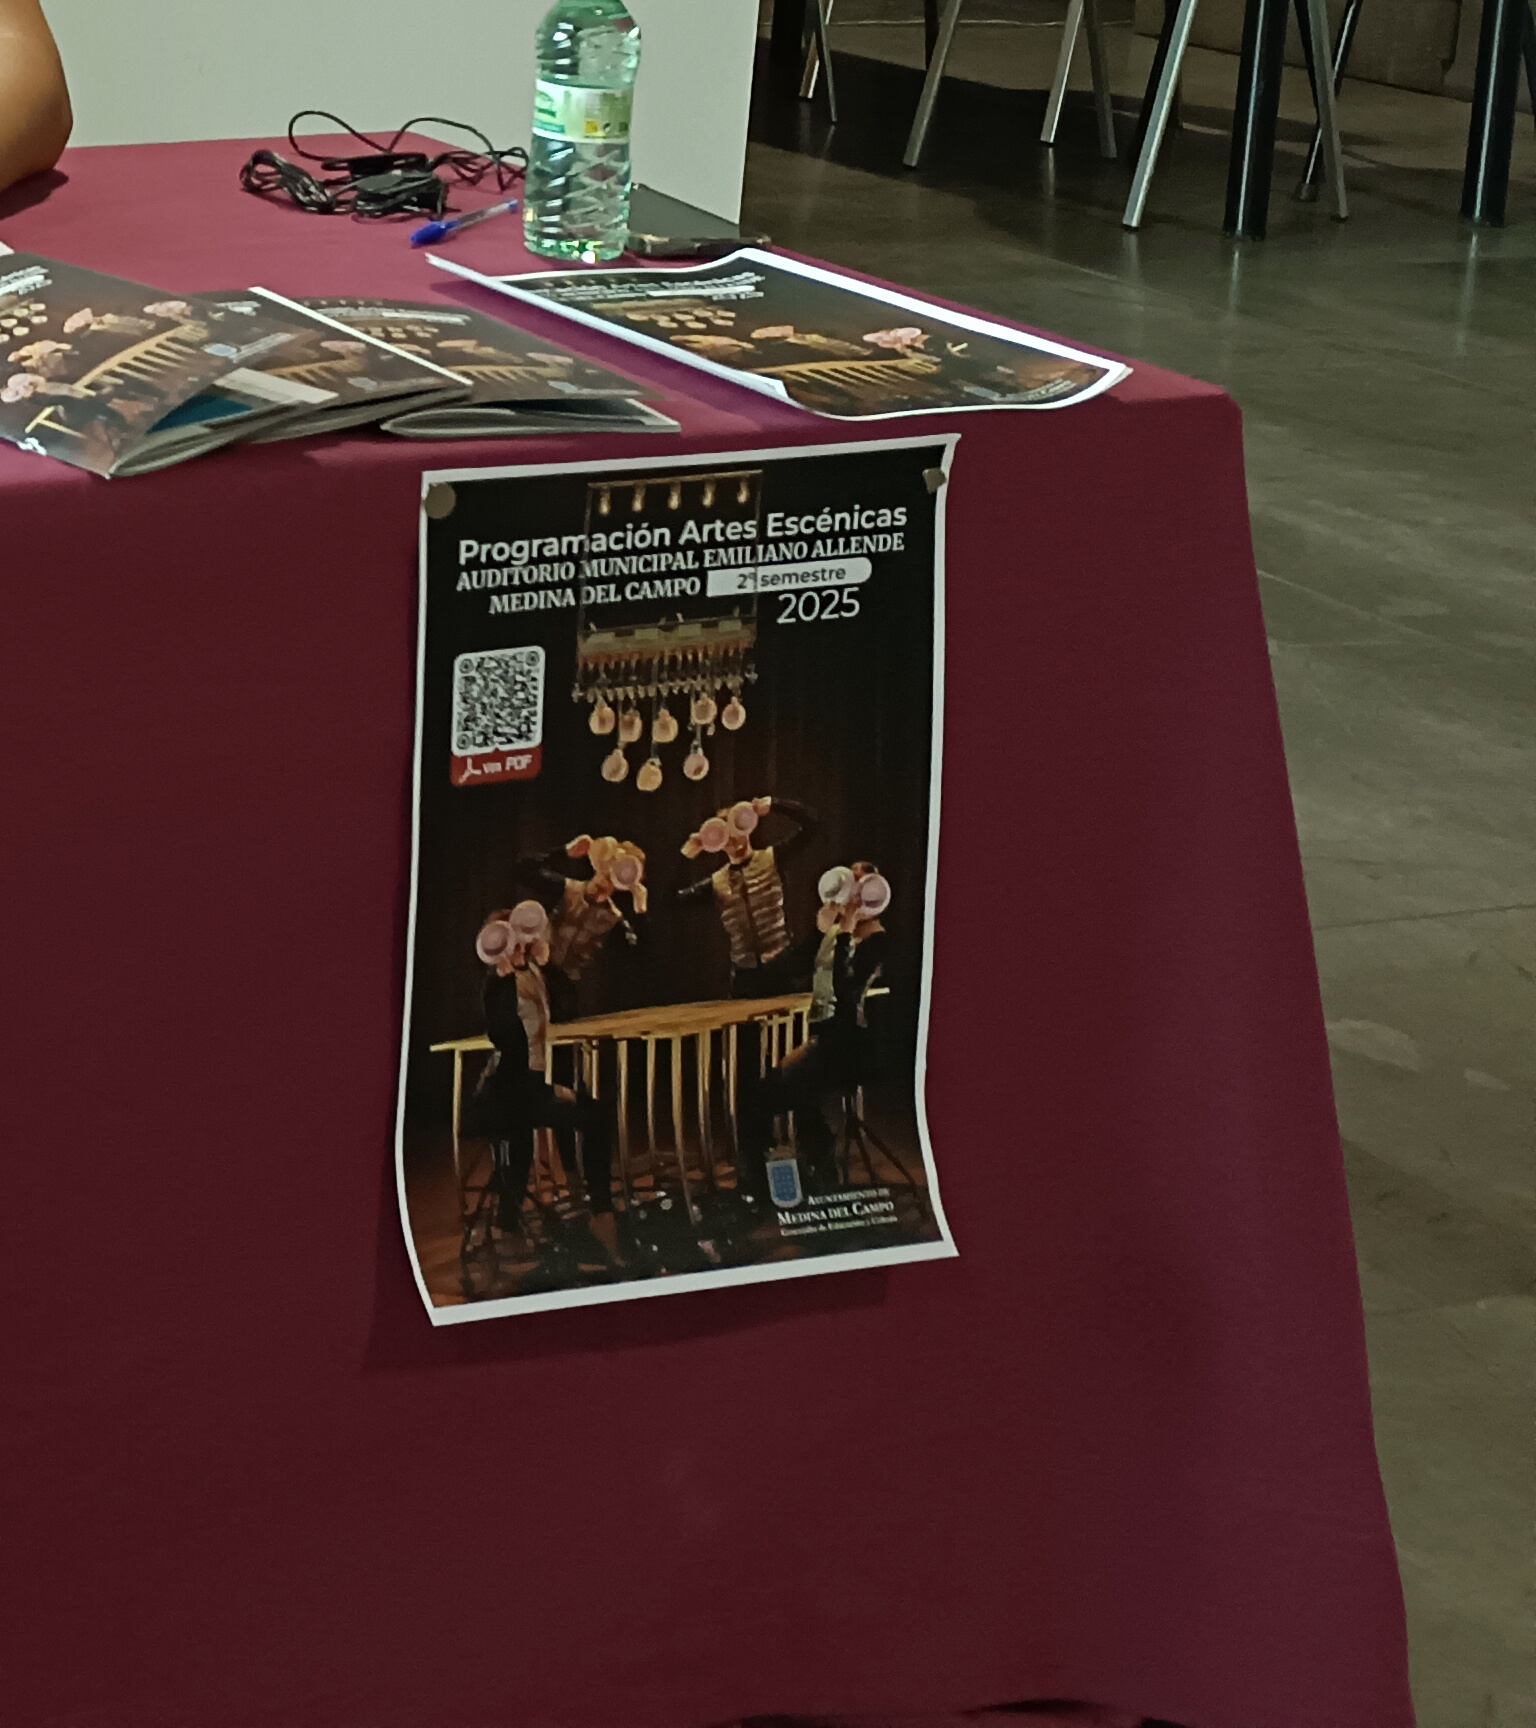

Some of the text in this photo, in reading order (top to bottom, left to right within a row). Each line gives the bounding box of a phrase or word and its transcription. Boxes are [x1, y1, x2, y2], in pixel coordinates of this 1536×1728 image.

[459, 505, 907, 565] Programación Artes Escénicas
[456, 533, 904, 591] AUDITORIO MUNICIPAL EMILIANO ALLENDE
[761, 566, 846, 586] semestre
[489, 577, 700, 614] MEDINA DEL CAMPO
[777, 587, 860, 624] 2025
